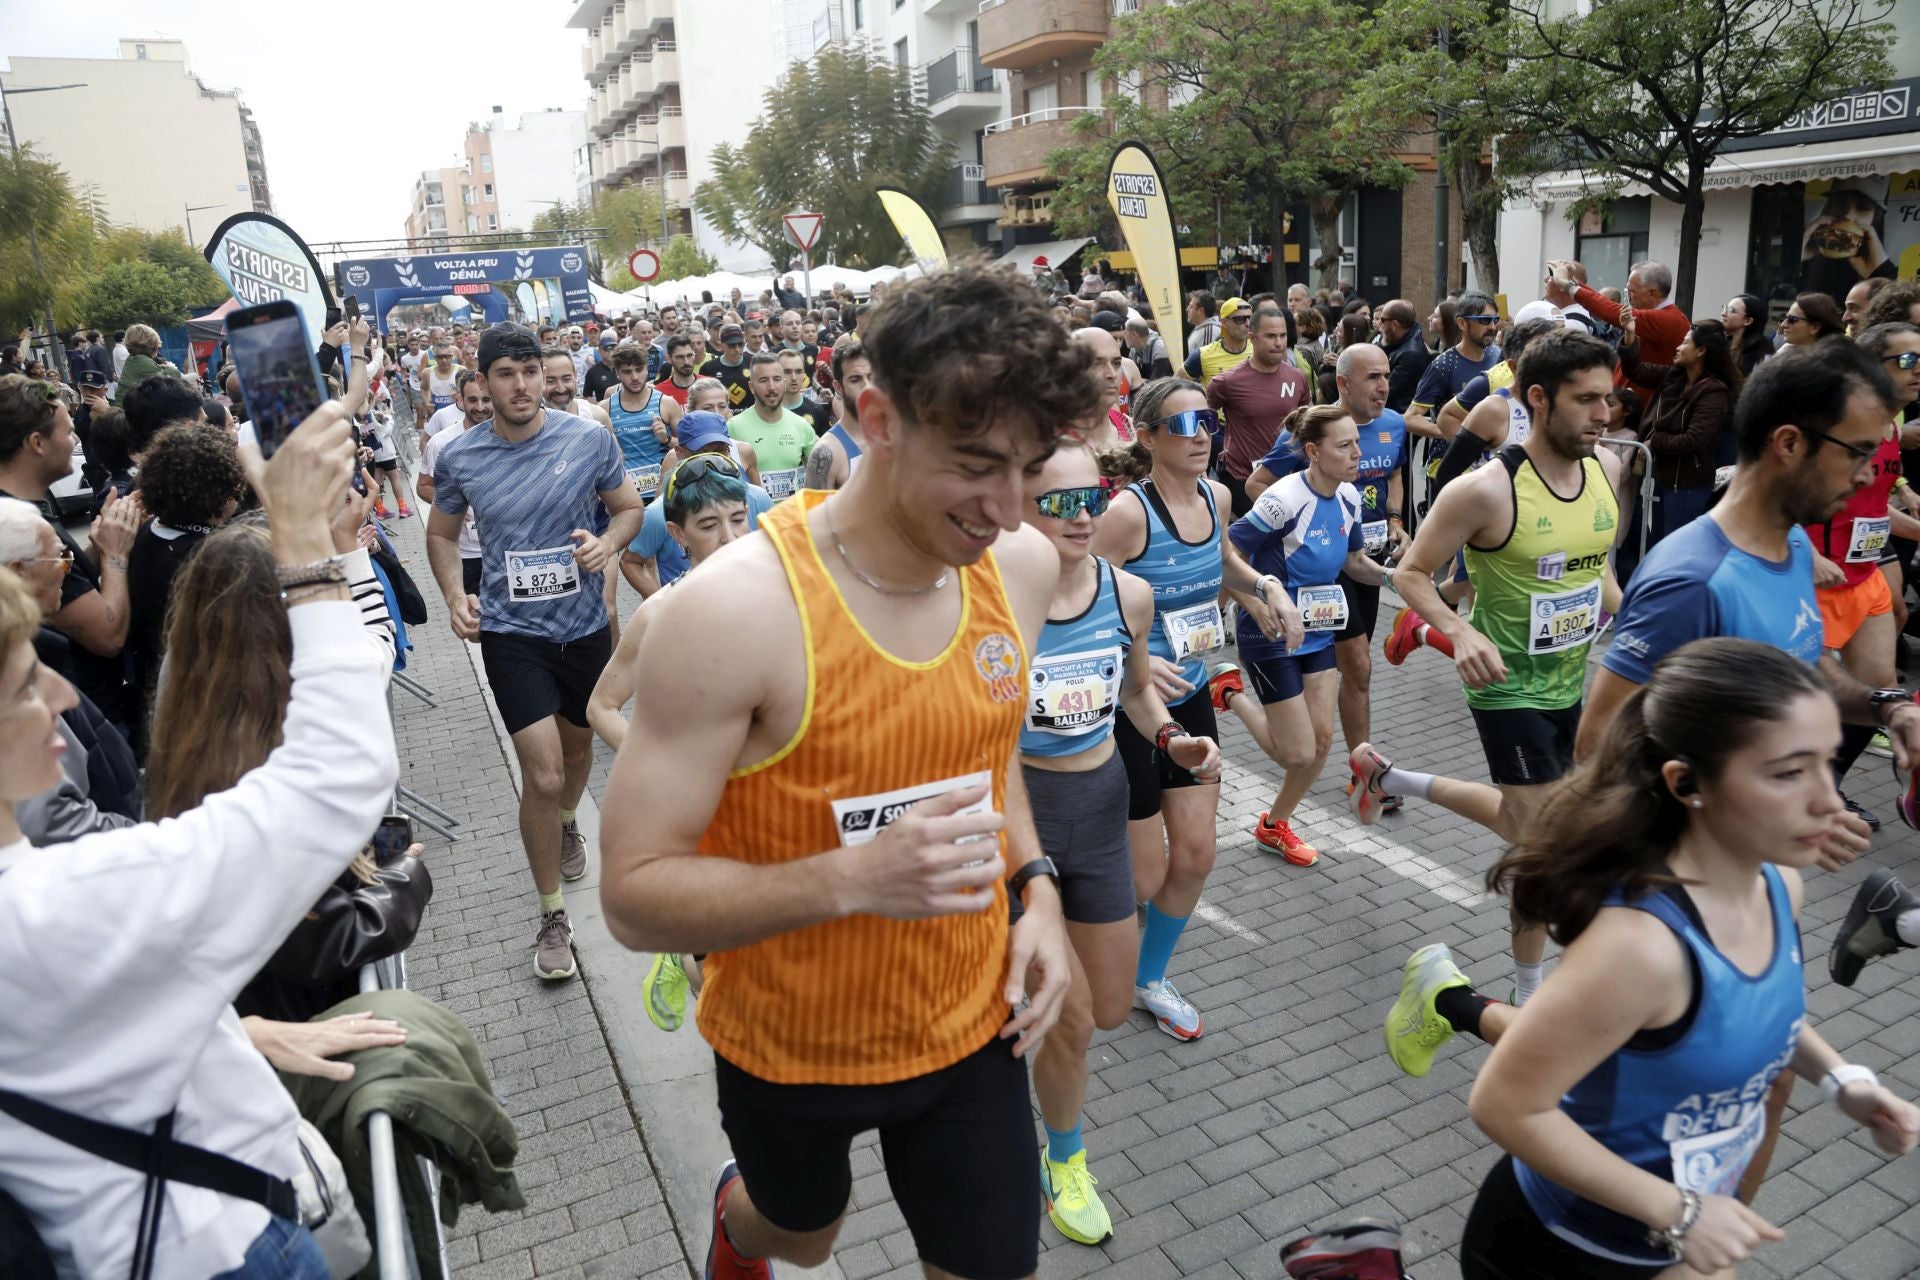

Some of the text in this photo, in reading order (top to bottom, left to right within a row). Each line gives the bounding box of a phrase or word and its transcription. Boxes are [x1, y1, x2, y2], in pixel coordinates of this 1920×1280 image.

[1702, 176, 1740, 187] BRADOR
[1750, 170, 1808, 182] PASTELERÍA
[1819, 163, 1876, 177] CAFETERÍA
[434, 258, 498, 270] VOLTA A PEU
[450, 269, 486, 281] DÉNIA
[1280, 381, 1296, 398] N
[772, 483, 790, 493] 1159
[516, 572, 557, 587] S 873
[1304, 607, 1333, 620] C 444
[1540, 613, 1586, 636] A 1307
[1183, 641, 1189, 655] A
[1048, 665, 1075, 674] CIRCUIT
[1083, 661, 1097, 669] PEU
[1065, 678, 1085, 686] POLLO
[1035, 689, 1093, 714] S 431
[1054, 710, 1101, 726] BALEARIA
